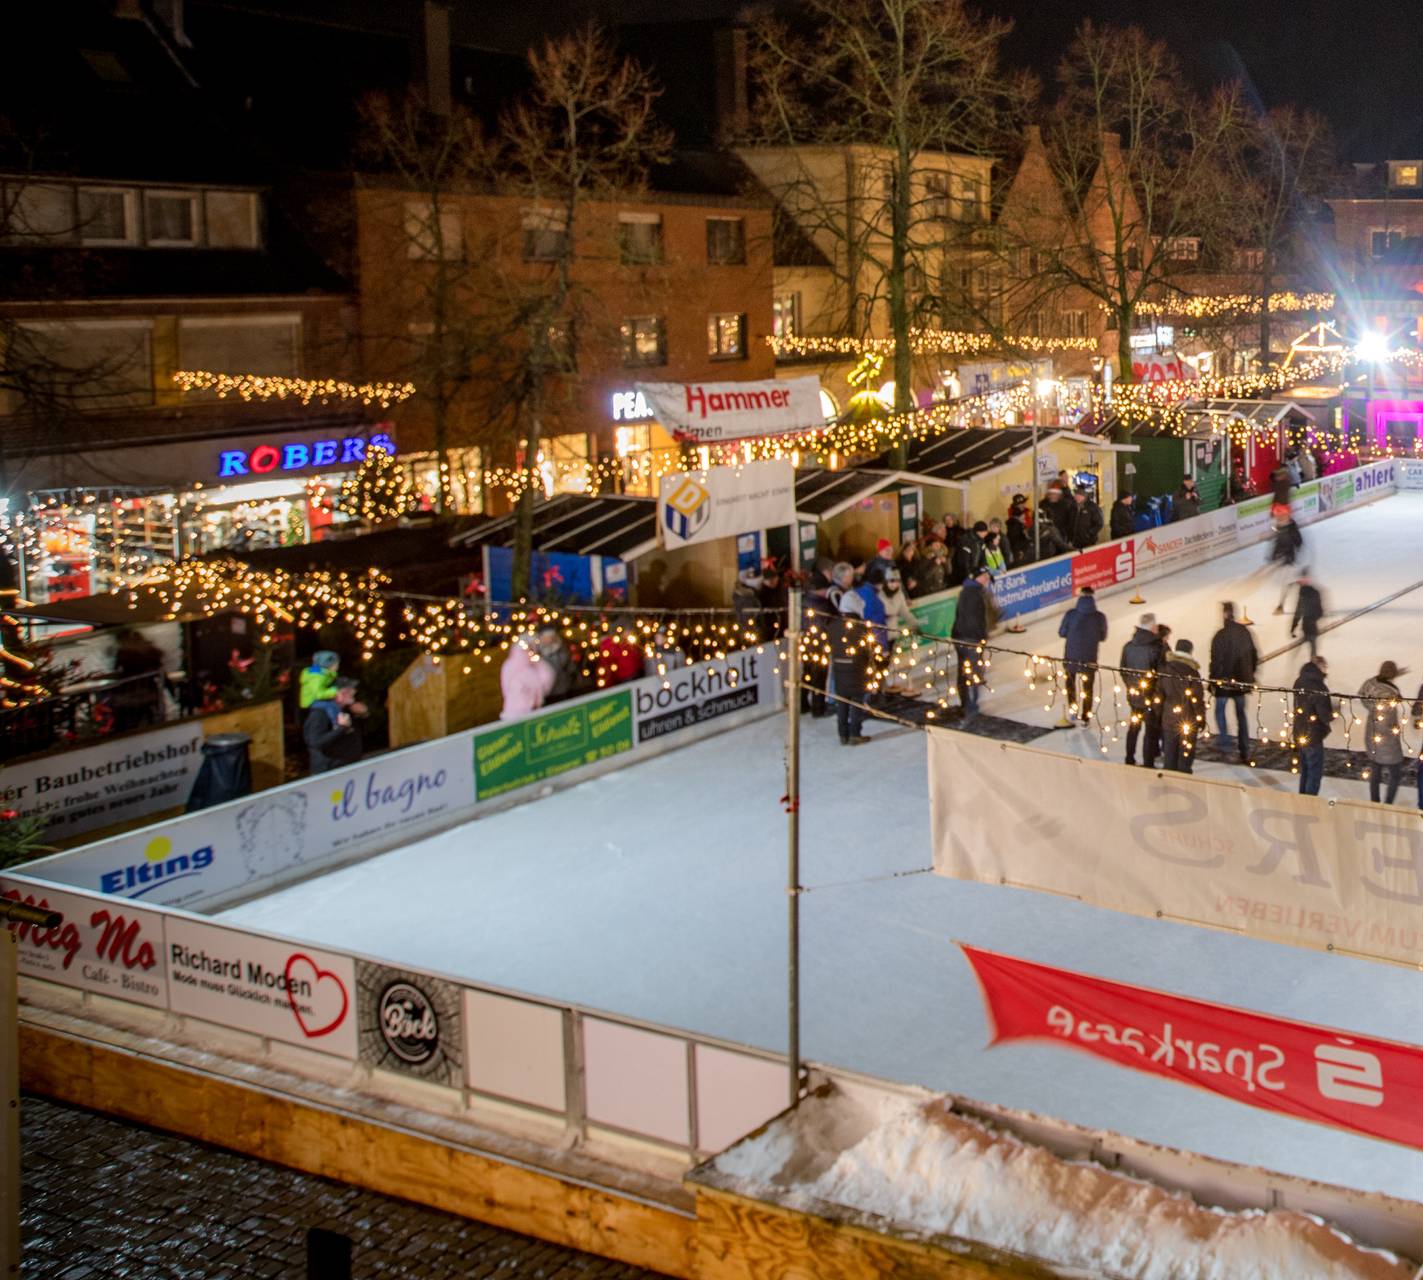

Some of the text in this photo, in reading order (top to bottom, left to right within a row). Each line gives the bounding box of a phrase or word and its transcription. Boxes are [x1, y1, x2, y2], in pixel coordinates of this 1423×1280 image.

[612, 391, 654, 420] PEA
[685, 386, 790, 418] Hammer
[217, 433, 397, 477] ROBERS
[1355, 466, 1395, 492] ahlert
[641, 690, 757, 740] uhren & schmuck
[35, 736, 200, 794] Baubetriebshof
[63, 790, 101, 808] frohe
[104, 766, 189, 795] Weihnachten
[69, 801, 105, 826] gutes
[108, 791, 147, 810] neues
[149, 782, 180, 799] Jahr
[330, 768, 448, 821] il bagno
[100, 844, 215, 895] Elting
[90, 909, 157, 971] Mo
[82, 965, 111, 985] Café
[121, 974, 160, 996] Bistro
[171, 944, 312, 998] Richard Moden
[172, 970, 198, 986] Mode
[199, 979, 225, 994] muss
[227, 982, 271, 1006] Glücklich
